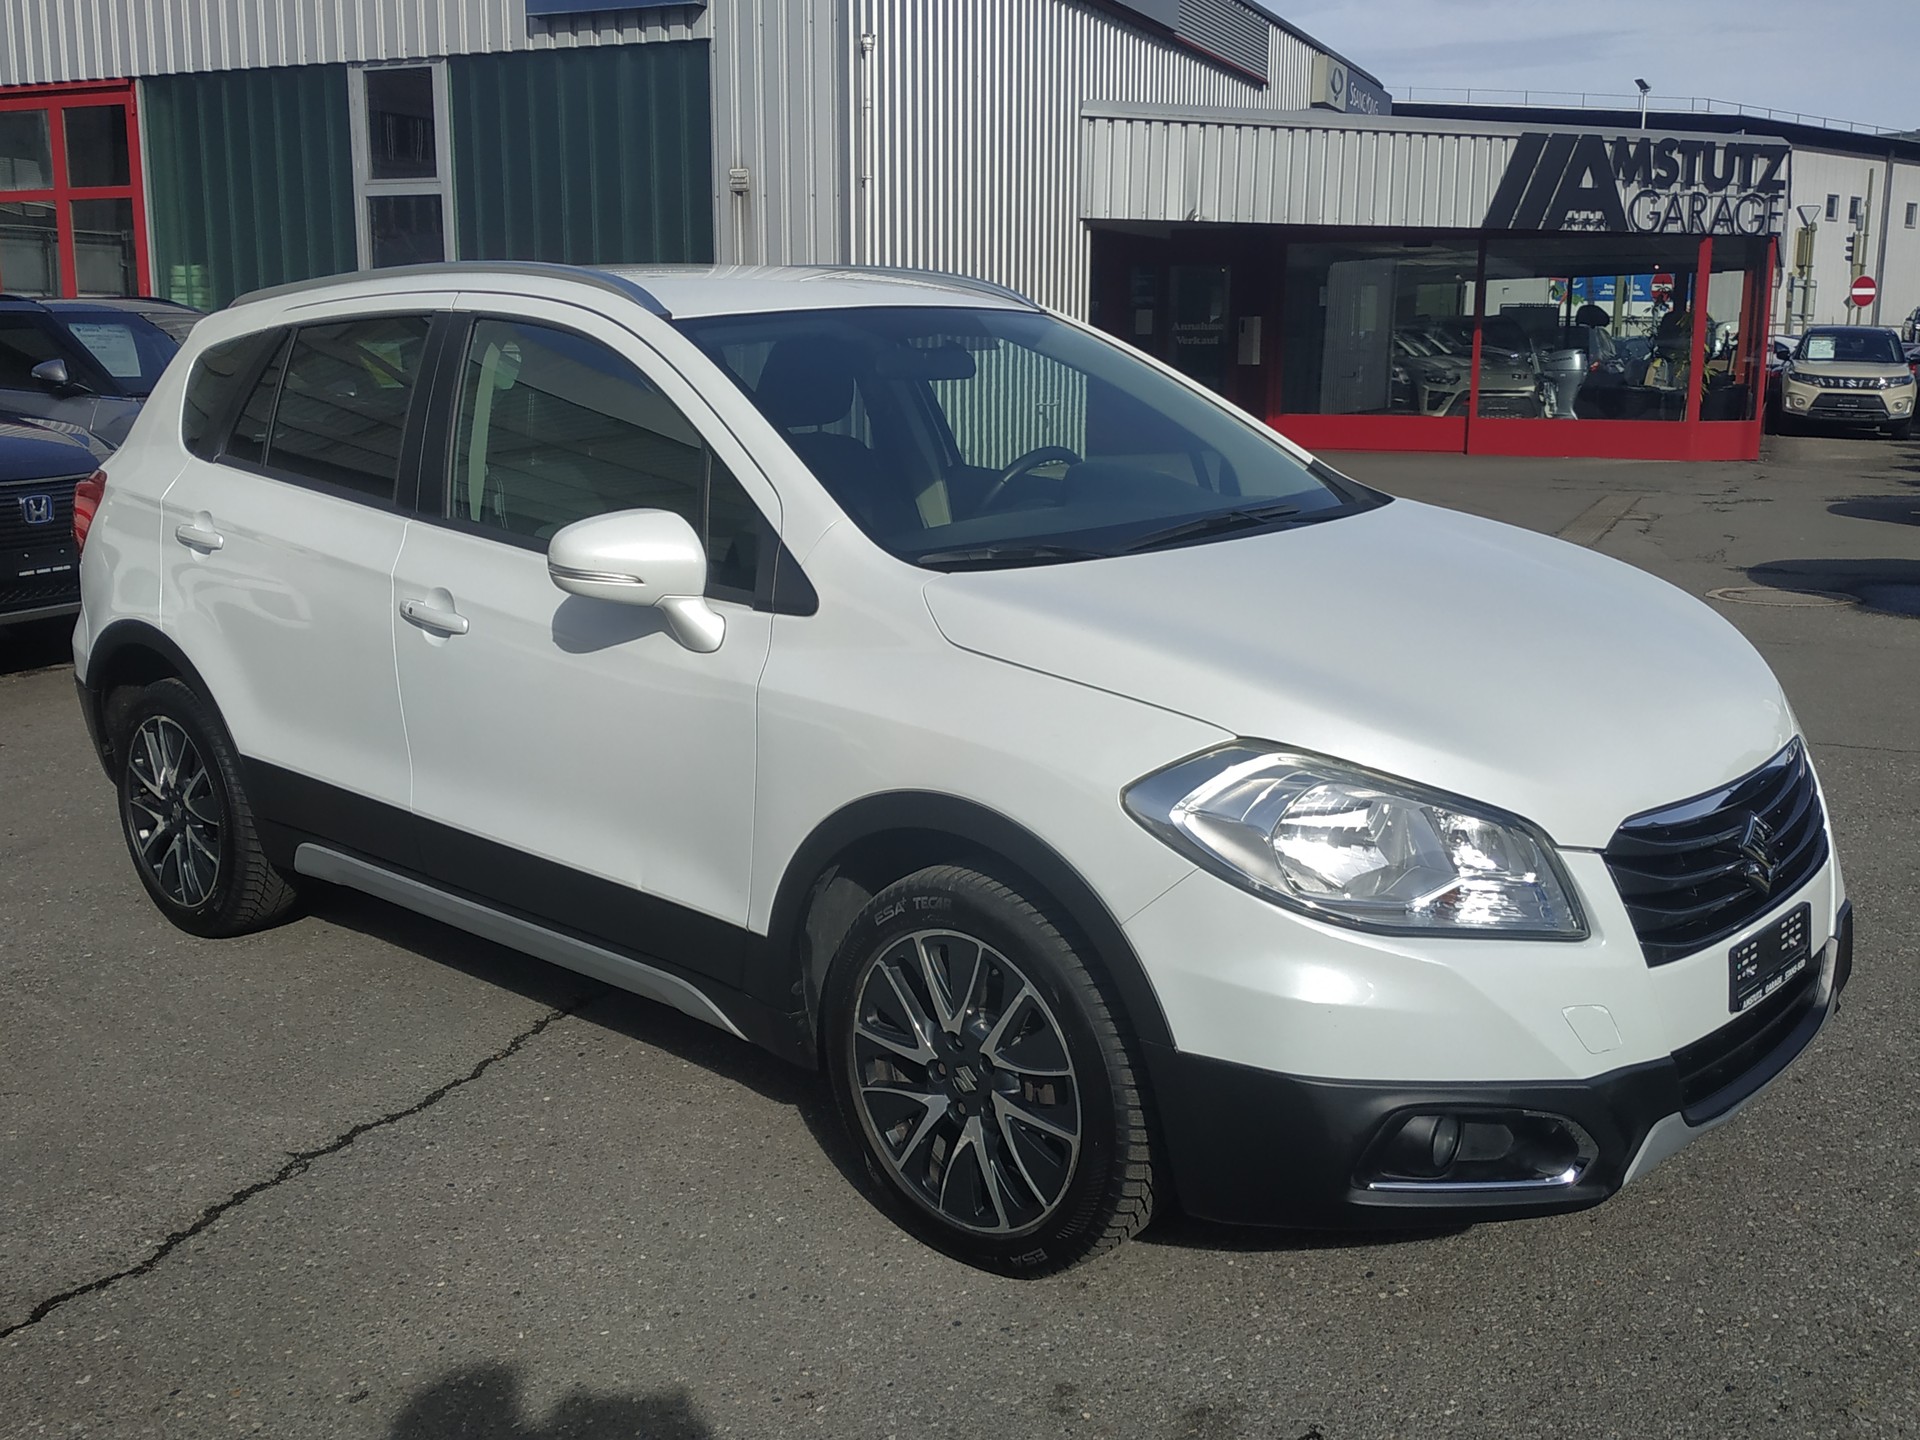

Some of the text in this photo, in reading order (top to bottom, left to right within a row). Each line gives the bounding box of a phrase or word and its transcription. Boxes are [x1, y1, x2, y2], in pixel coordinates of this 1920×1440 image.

[1540, 133, 1791, 231] AMSTUTZ
[1627, 189, 1785, 236] GARAGE
[1176, 336, 1219, 345] Verkauf
